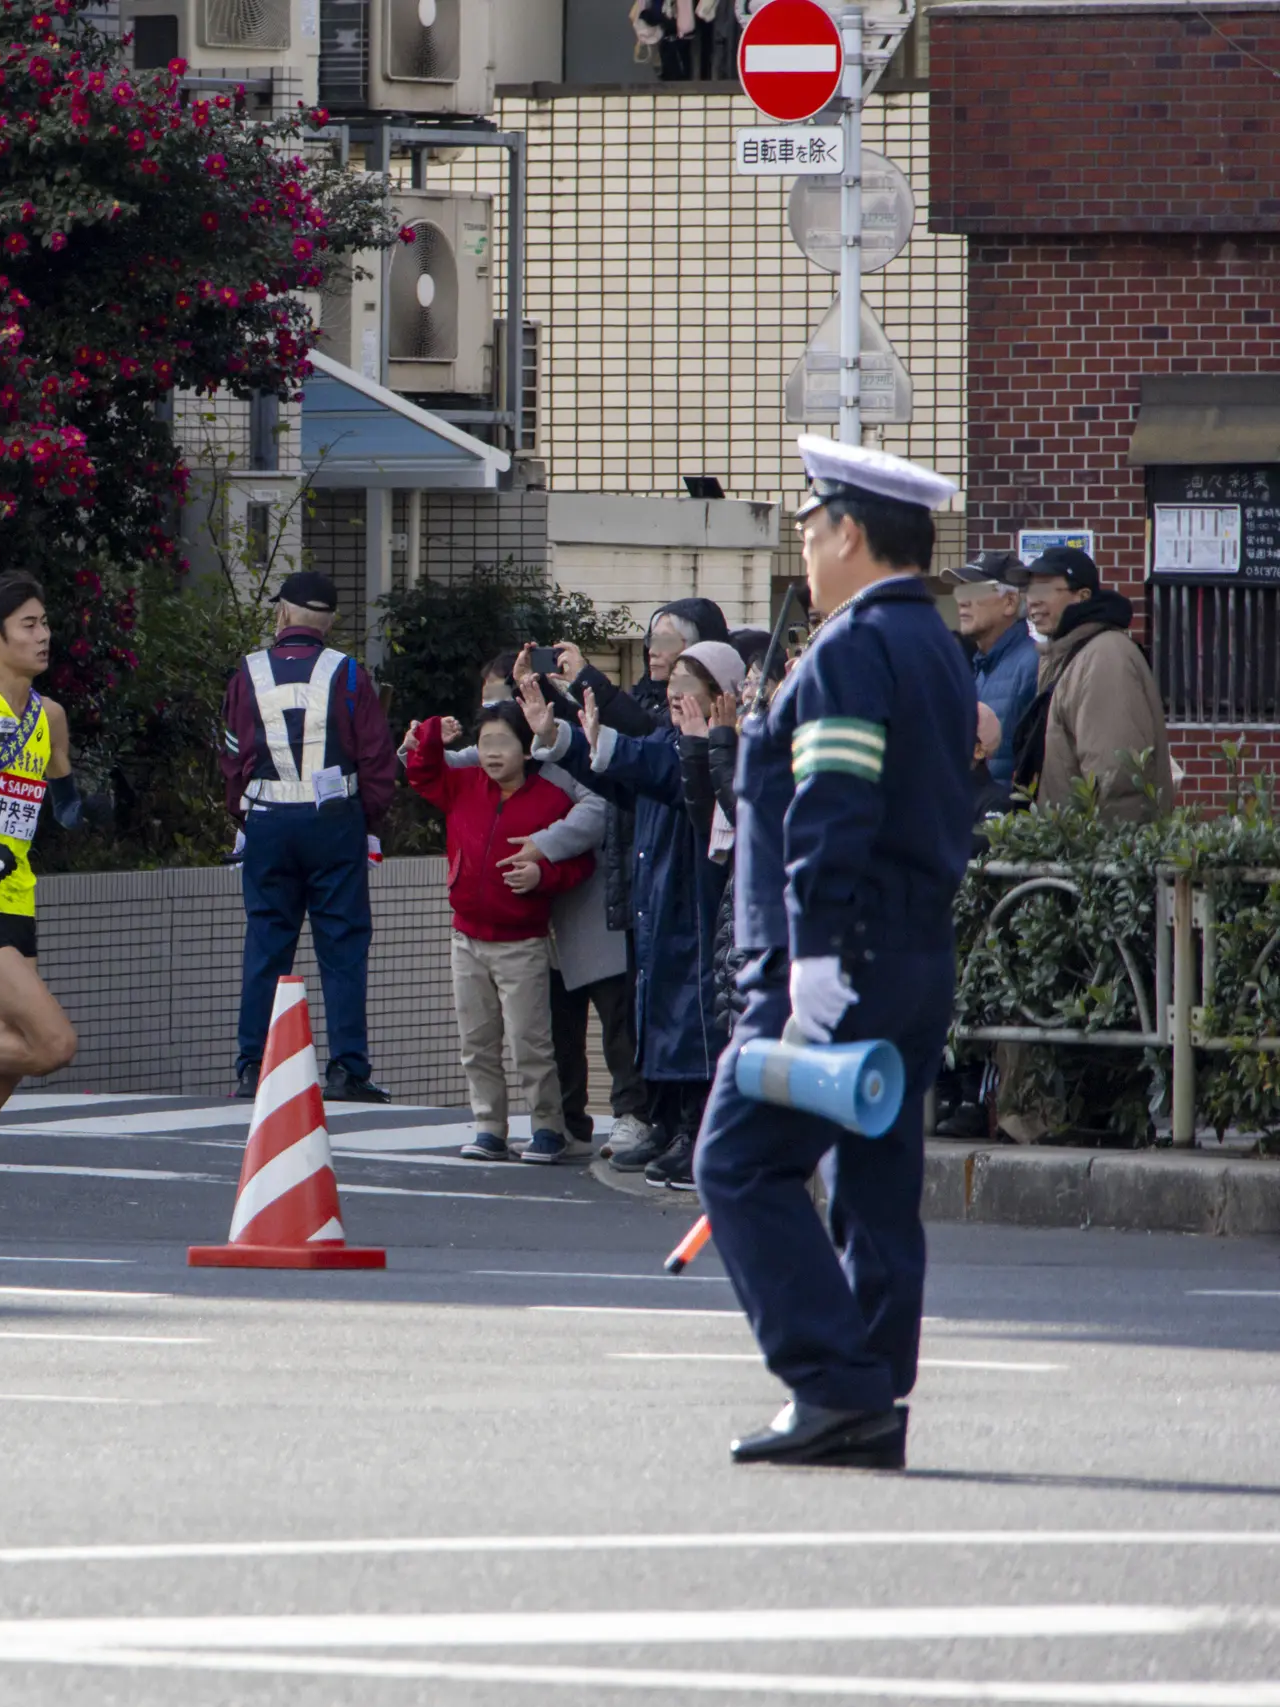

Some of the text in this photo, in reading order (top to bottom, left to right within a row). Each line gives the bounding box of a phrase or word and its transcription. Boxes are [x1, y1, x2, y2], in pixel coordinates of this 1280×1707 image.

[743, 138, 838, 164] 自転車を除く
